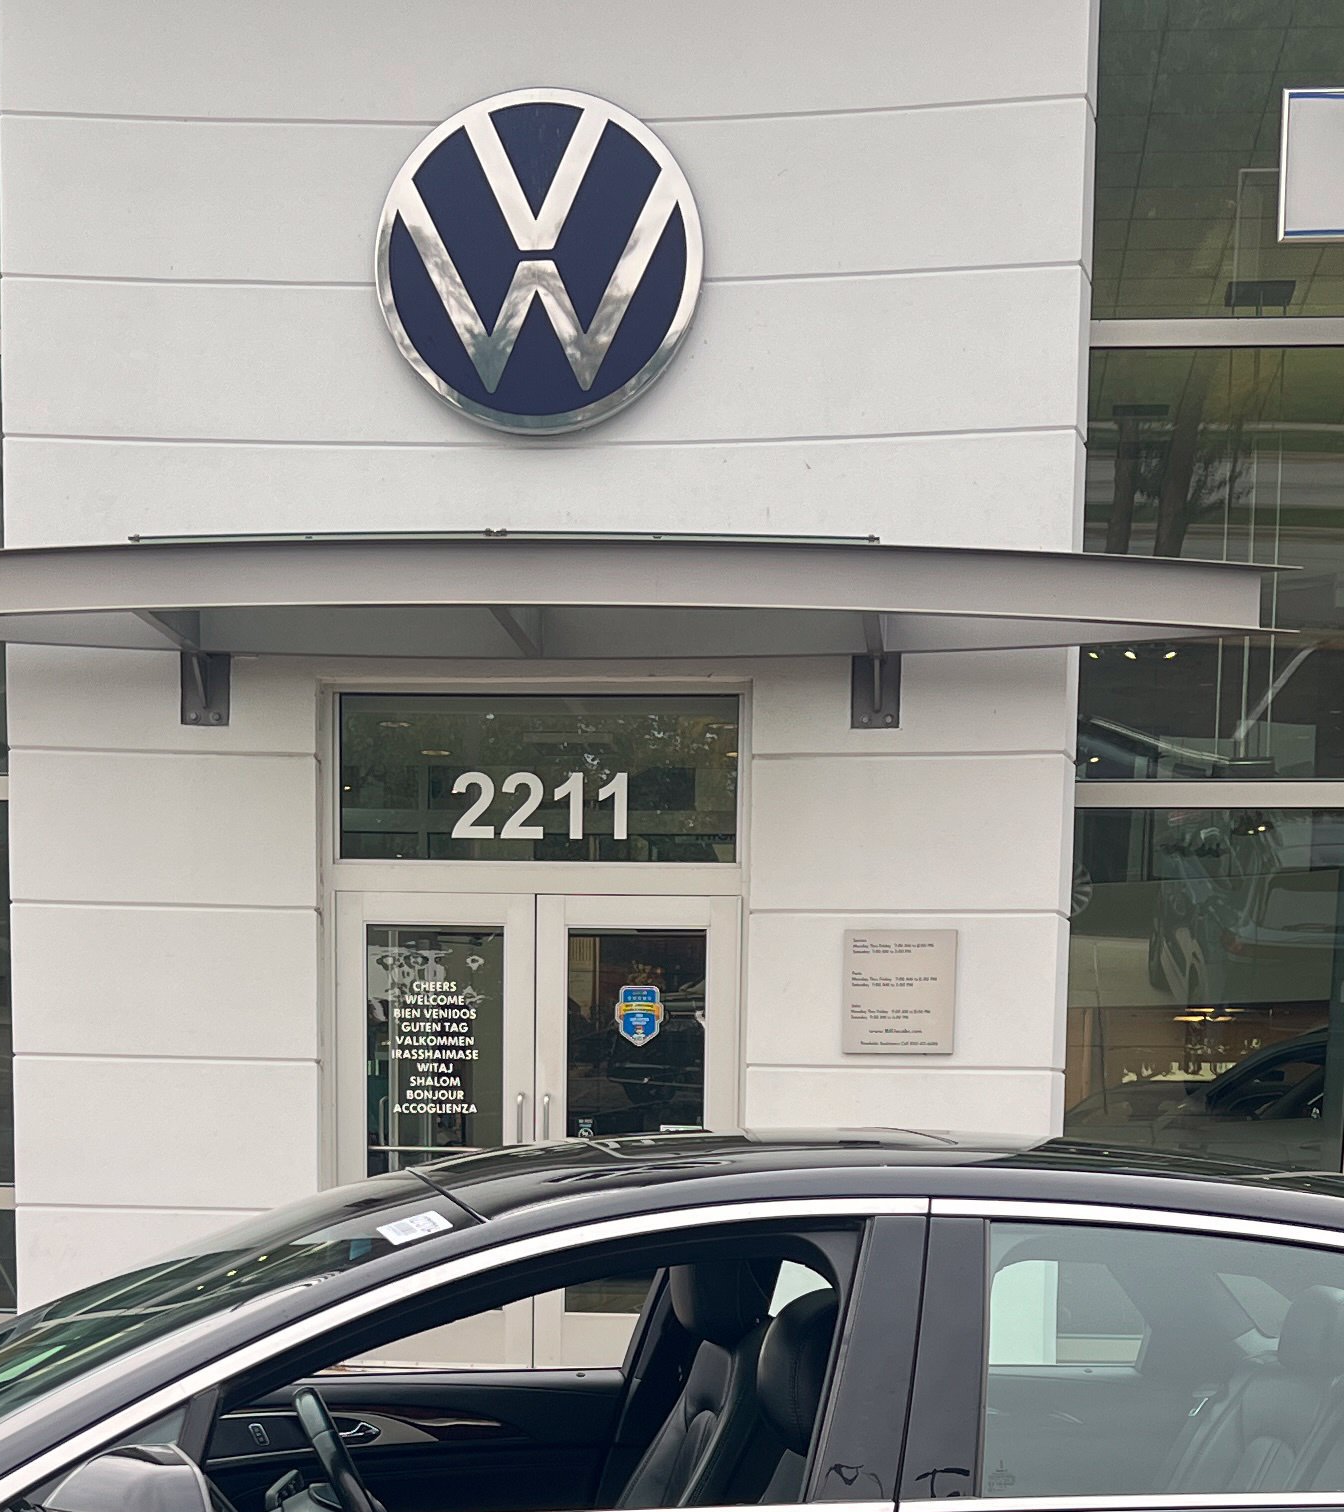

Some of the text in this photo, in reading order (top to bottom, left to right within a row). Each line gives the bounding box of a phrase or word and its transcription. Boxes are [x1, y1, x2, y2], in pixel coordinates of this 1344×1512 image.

[451, 771, 628, 841] 2211
[412, 981, 457, 992] CHEERS
[404, 994, 465, 1006] WELCOME
[393, 1008, 477, 1020] BIEN VENIDOS
[401, 1022, 469, 1033] GUTEN TAG
[395, 1035, 475, 1046] VALKOMMEN
[391, 1049, 479, 1060] IRASSHAIMASE
[416, 1062, 453, 1073] WITAJ
[409, 1076, 461, 1087] SHALOM
[406, 1089, 464, 1100] BONJOUR
[393, 1103, 477, 1114] ACCOGLIENZA
